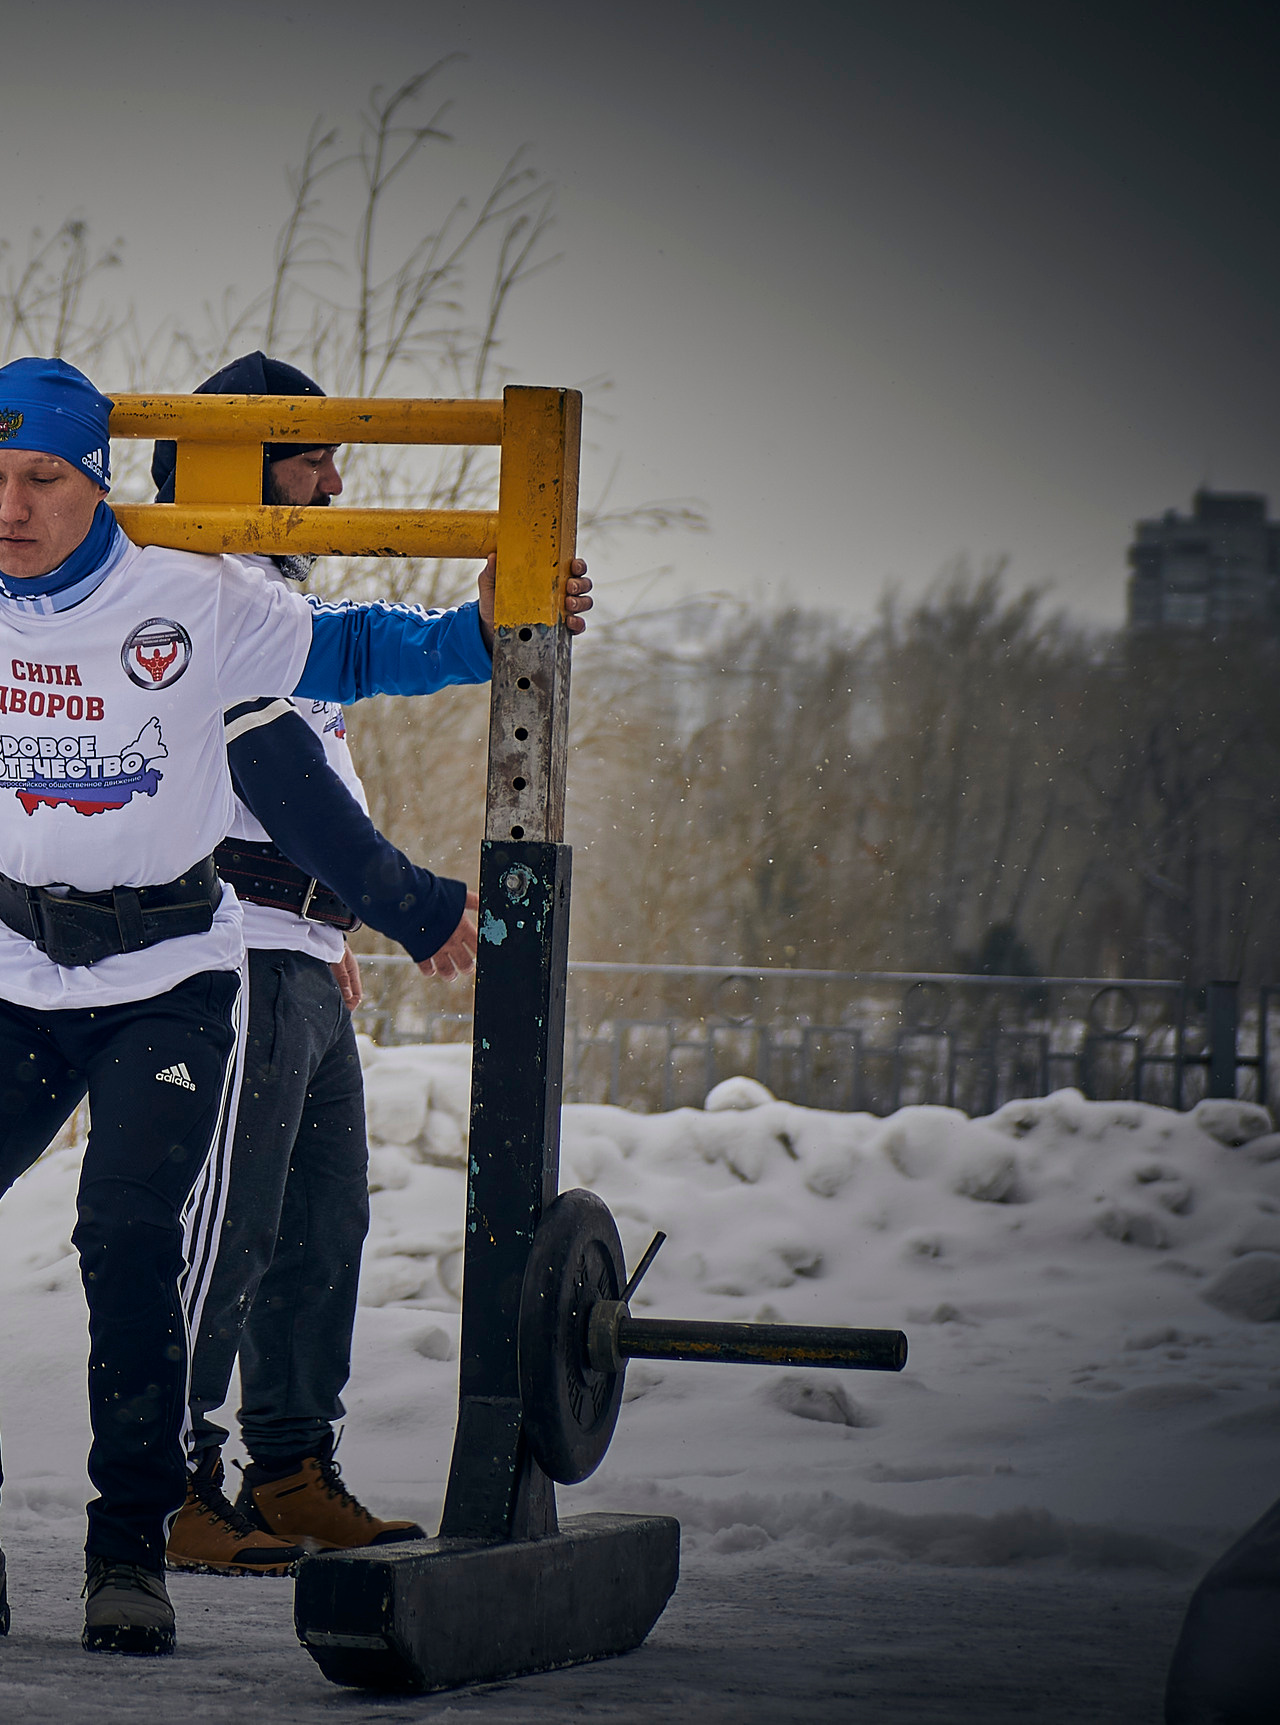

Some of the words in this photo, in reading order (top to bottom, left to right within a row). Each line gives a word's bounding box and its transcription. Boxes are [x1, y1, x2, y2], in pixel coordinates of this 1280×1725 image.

[81, 456, 104, 478] adidas
[11, 659, 83, 686] СИЛА
[48, 780, 102, 790] общественное
[103, 775, 142, 788] движение
[155, 1072, 196, 1092] adidas
